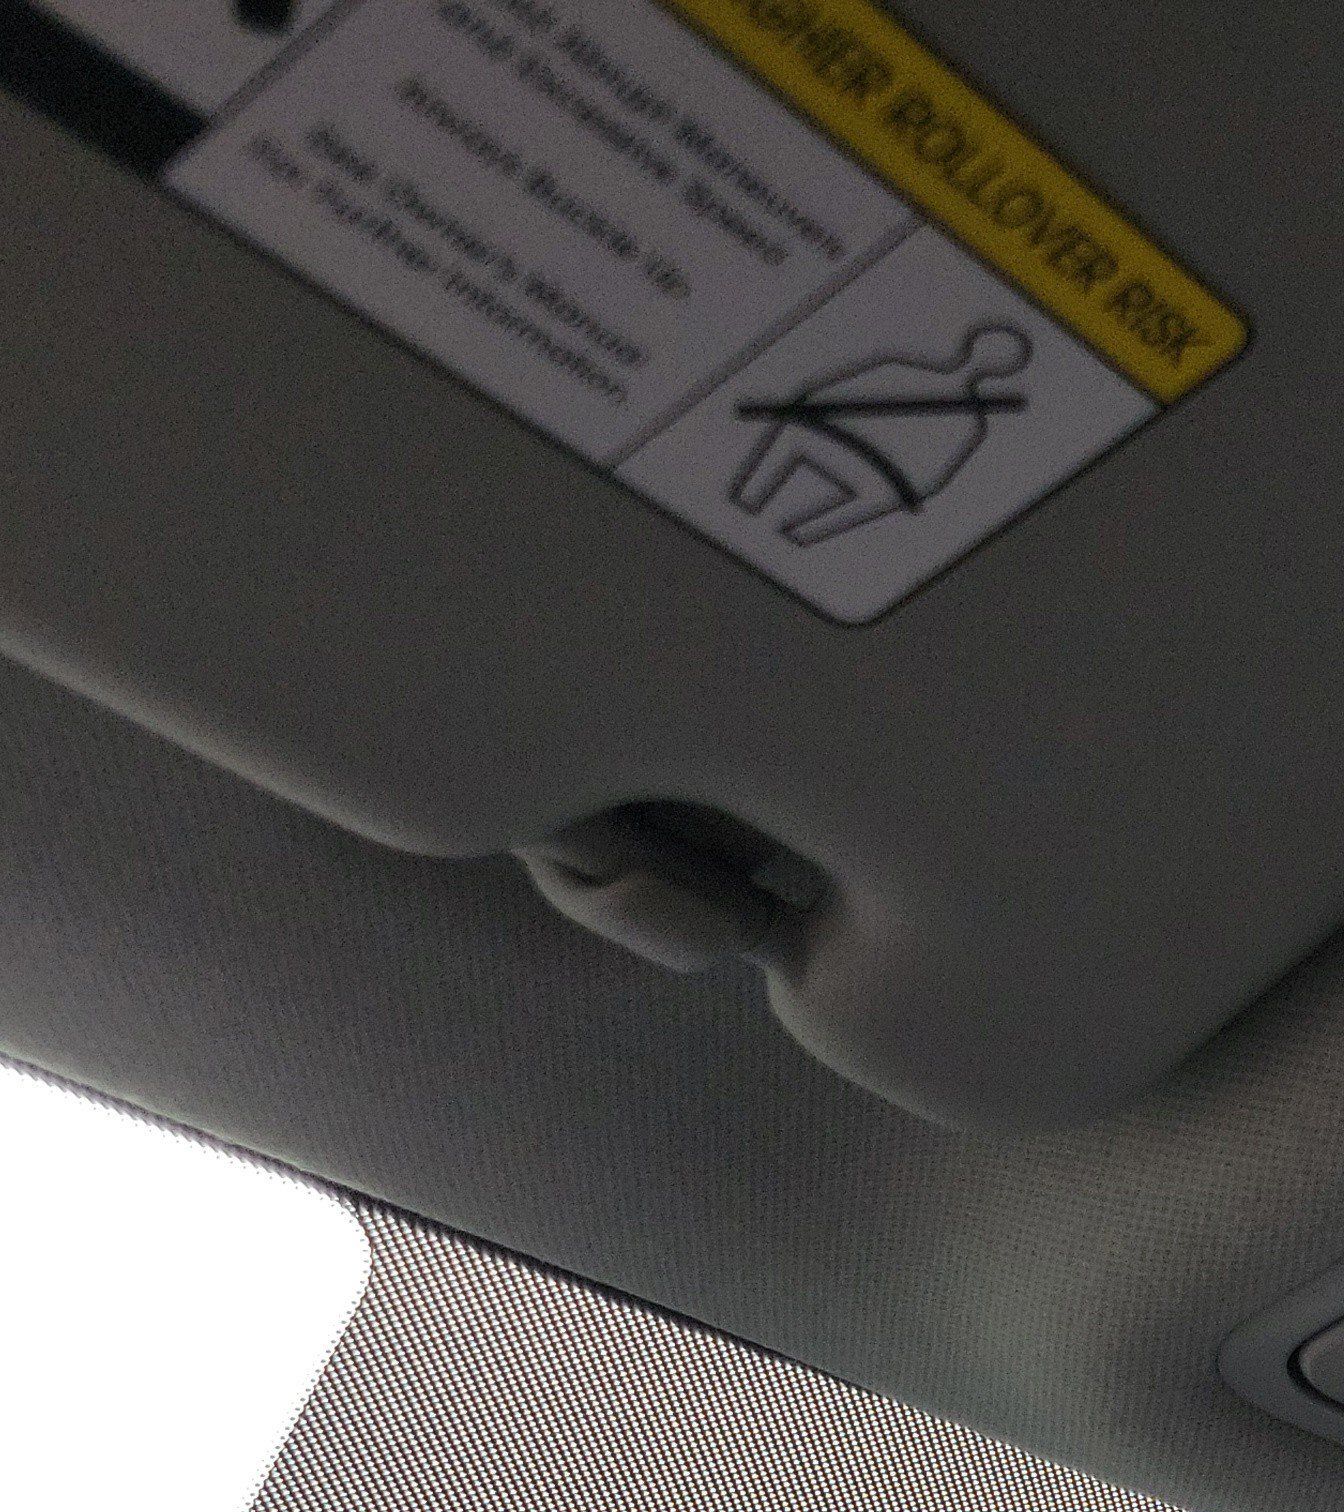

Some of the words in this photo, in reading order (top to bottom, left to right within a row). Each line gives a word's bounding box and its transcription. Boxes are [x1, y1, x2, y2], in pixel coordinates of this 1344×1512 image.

[746, 0, 895, 104] GHER
[886, 85, 1120, 297] ROLLOVER
[1105, 275, 1211, 372] RISK
